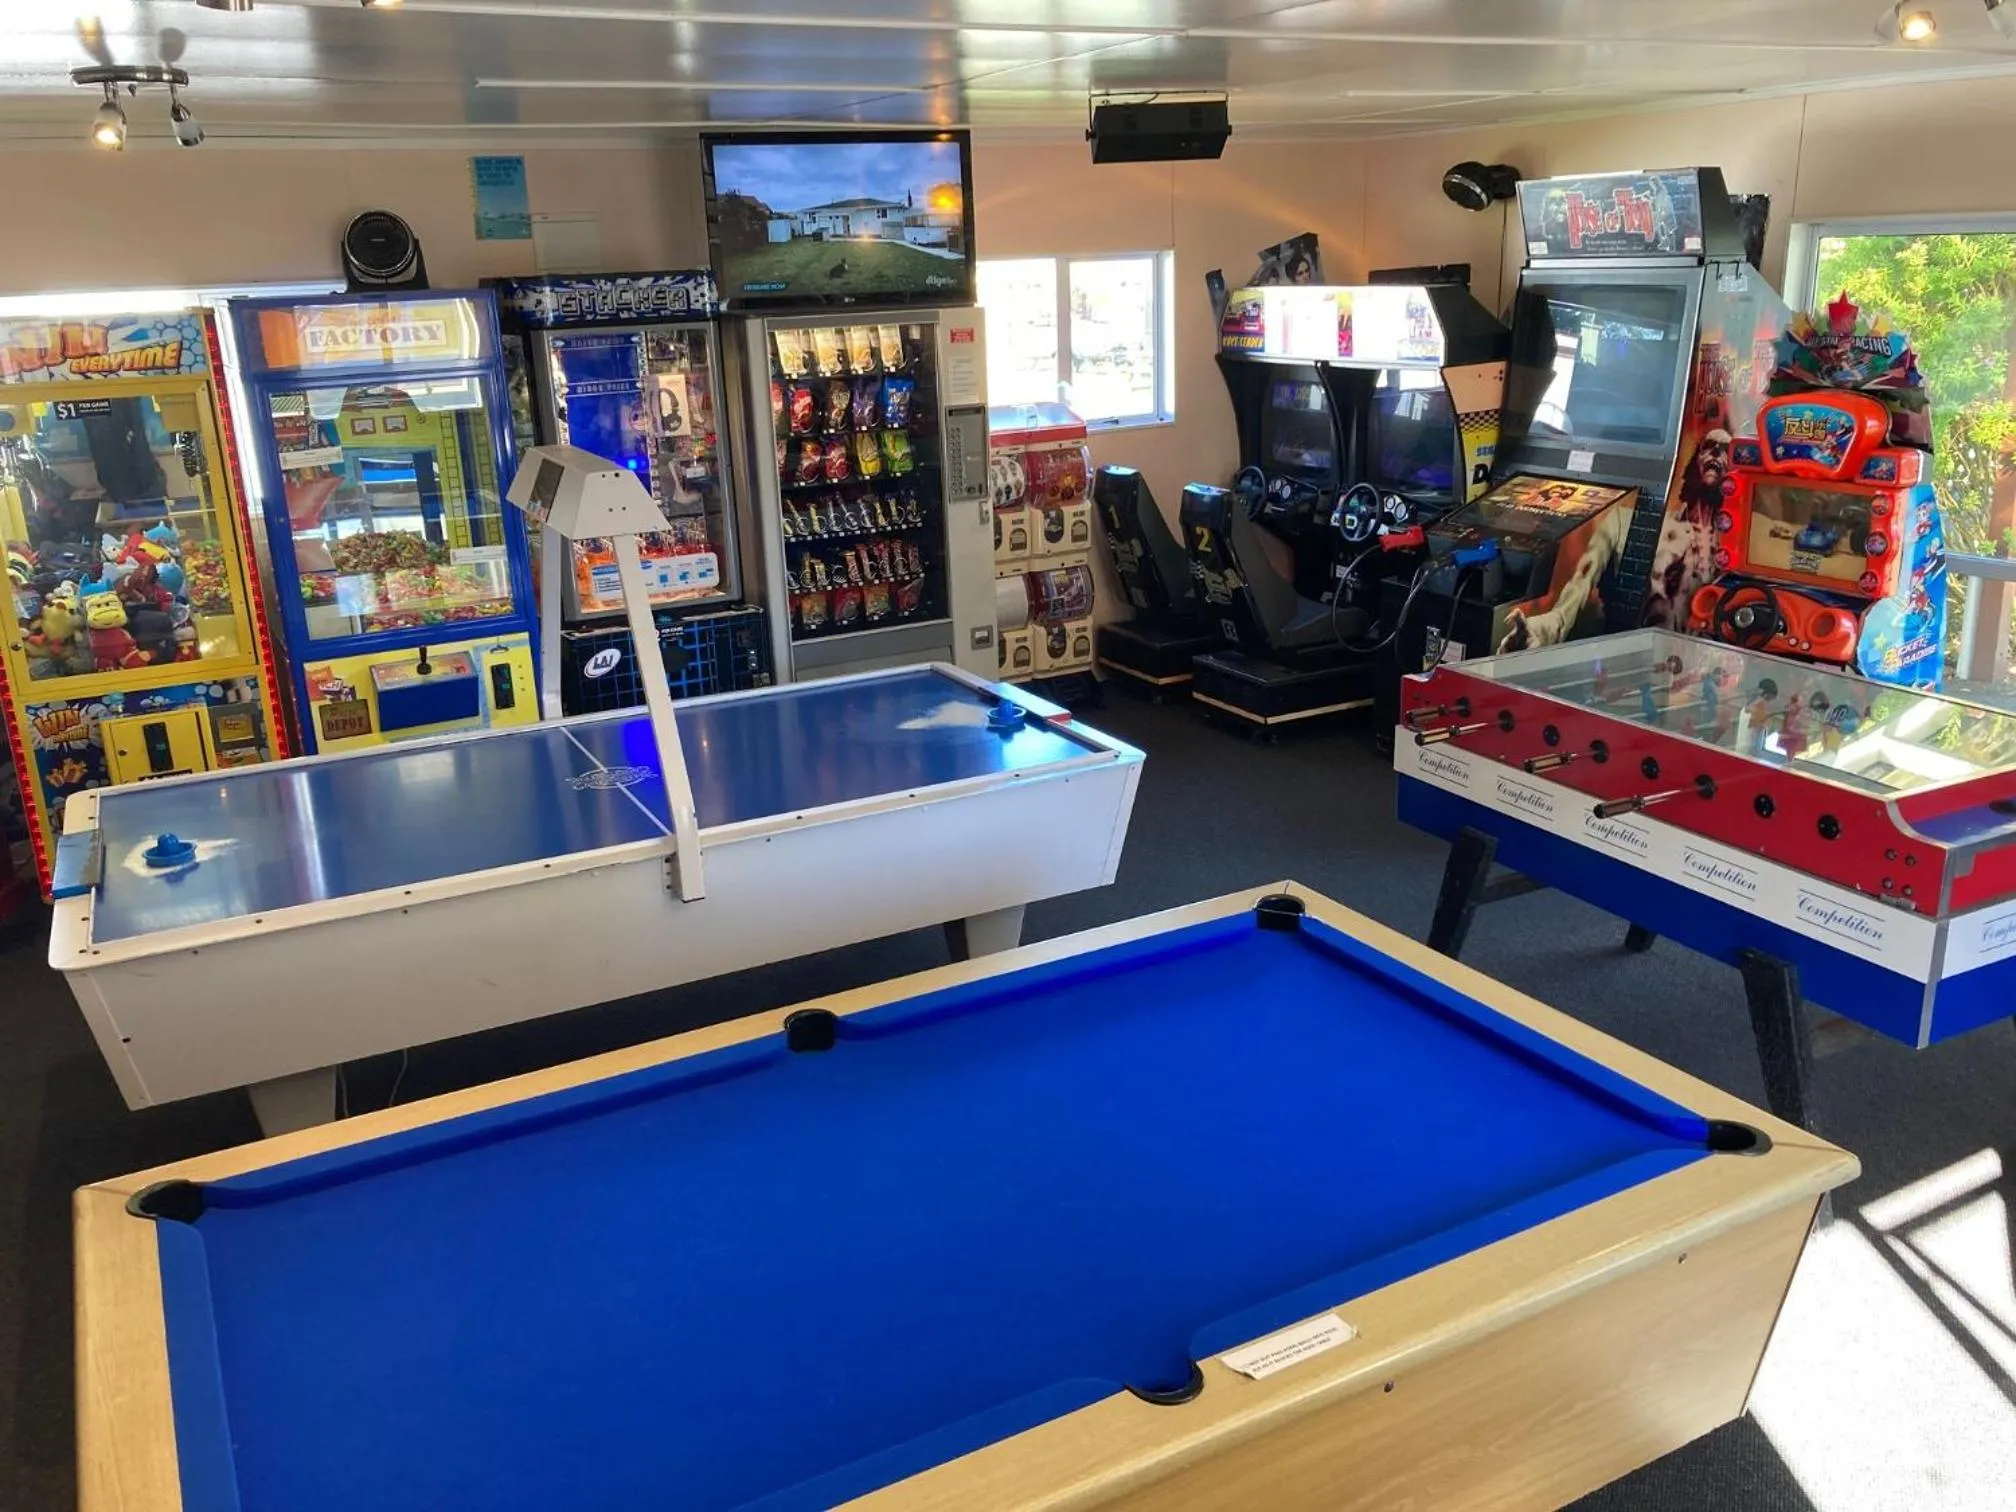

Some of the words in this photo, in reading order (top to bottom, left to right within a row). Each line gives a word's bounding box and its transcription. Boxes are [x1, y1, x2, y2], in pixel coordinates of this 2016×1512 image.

[558, 284, 691, 316] STACKER
[308, 323, 442, 347] FACTORY
[70, 341, 183, 375] EVERYTIME
[57, 402, 76, 419] $1
[1108, 504, 1120, 529] 1
[1195, 526, 1212, 553] 2
[326, 716, 364, 733] DEPOT
[1417, 749, 1470, 781] Competition
[1496, 779, 1554, 813] Competition
[1584, 812, 1649, 850] Competition
[1681, 849, 1757, 892] Competition
[1797, 893, 1884, 941] Competition
